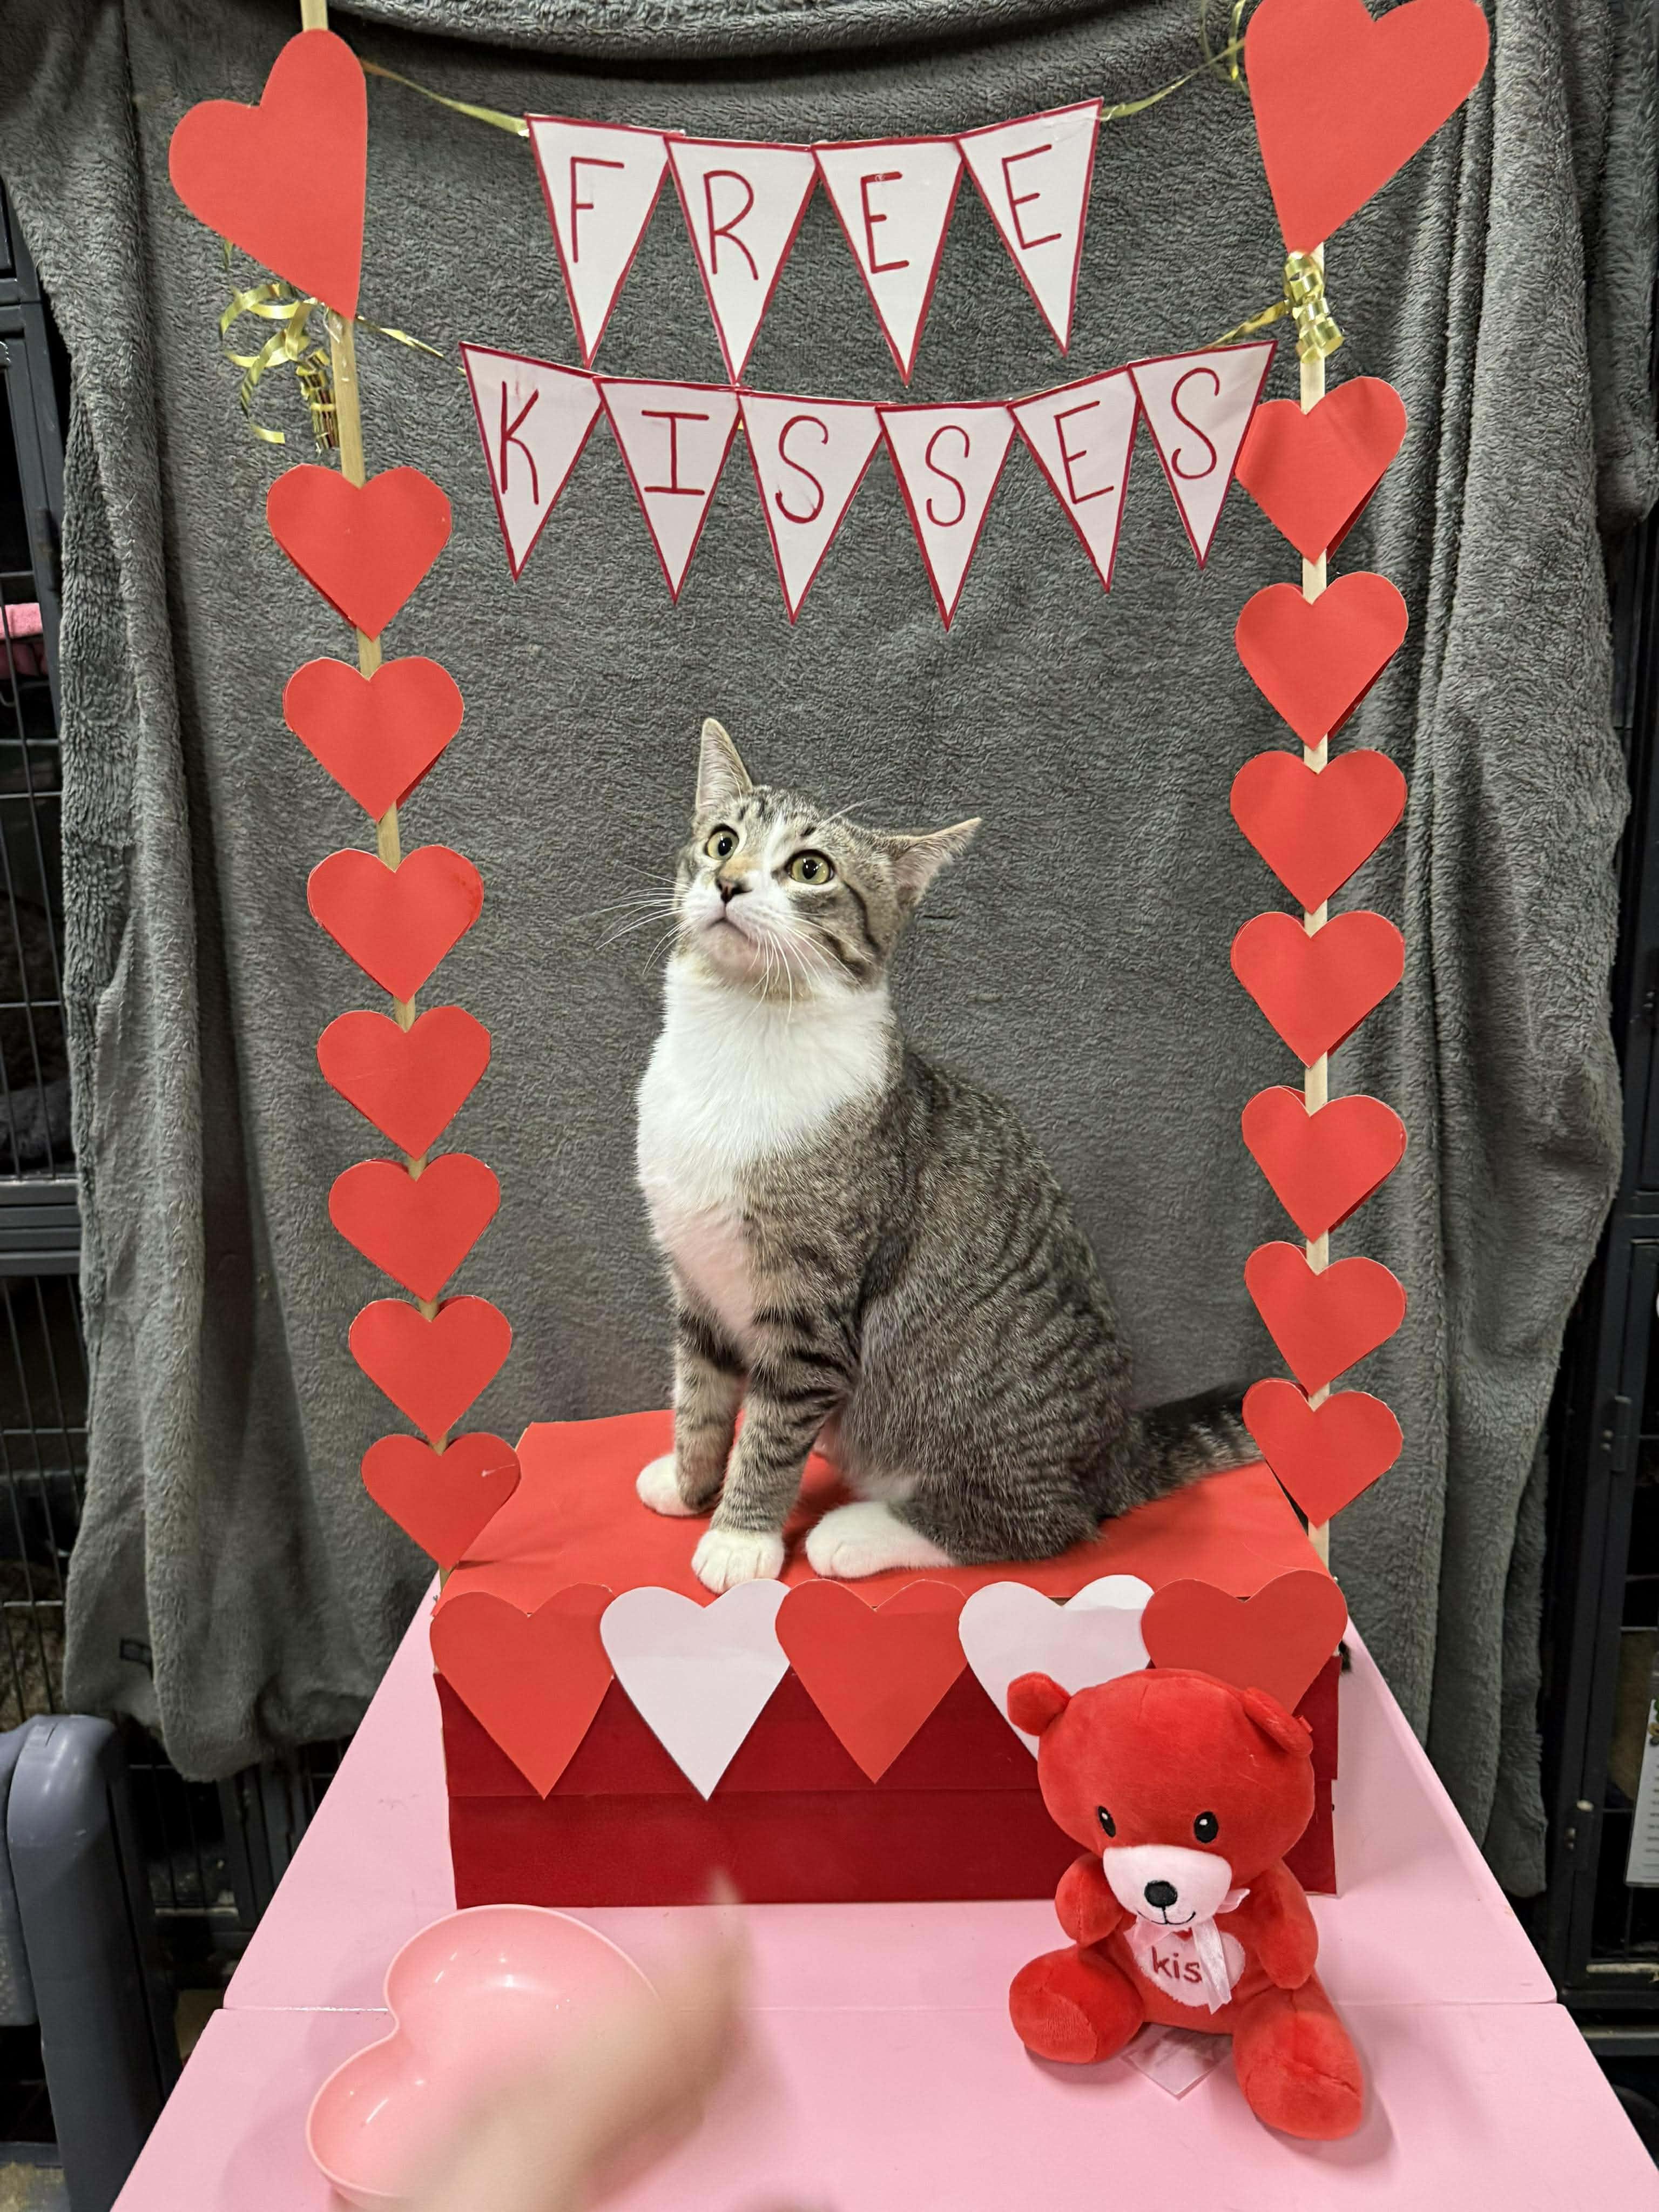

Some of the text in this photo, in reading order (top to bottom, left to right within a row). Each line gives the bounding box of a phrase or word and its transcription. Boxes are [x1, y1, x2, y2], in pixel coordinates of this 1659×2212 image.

[571, 144, 1062, 281] FREE
[501, 367, 1221, 527] KISSES
[1151, 1945, 1203, 1984] kis
